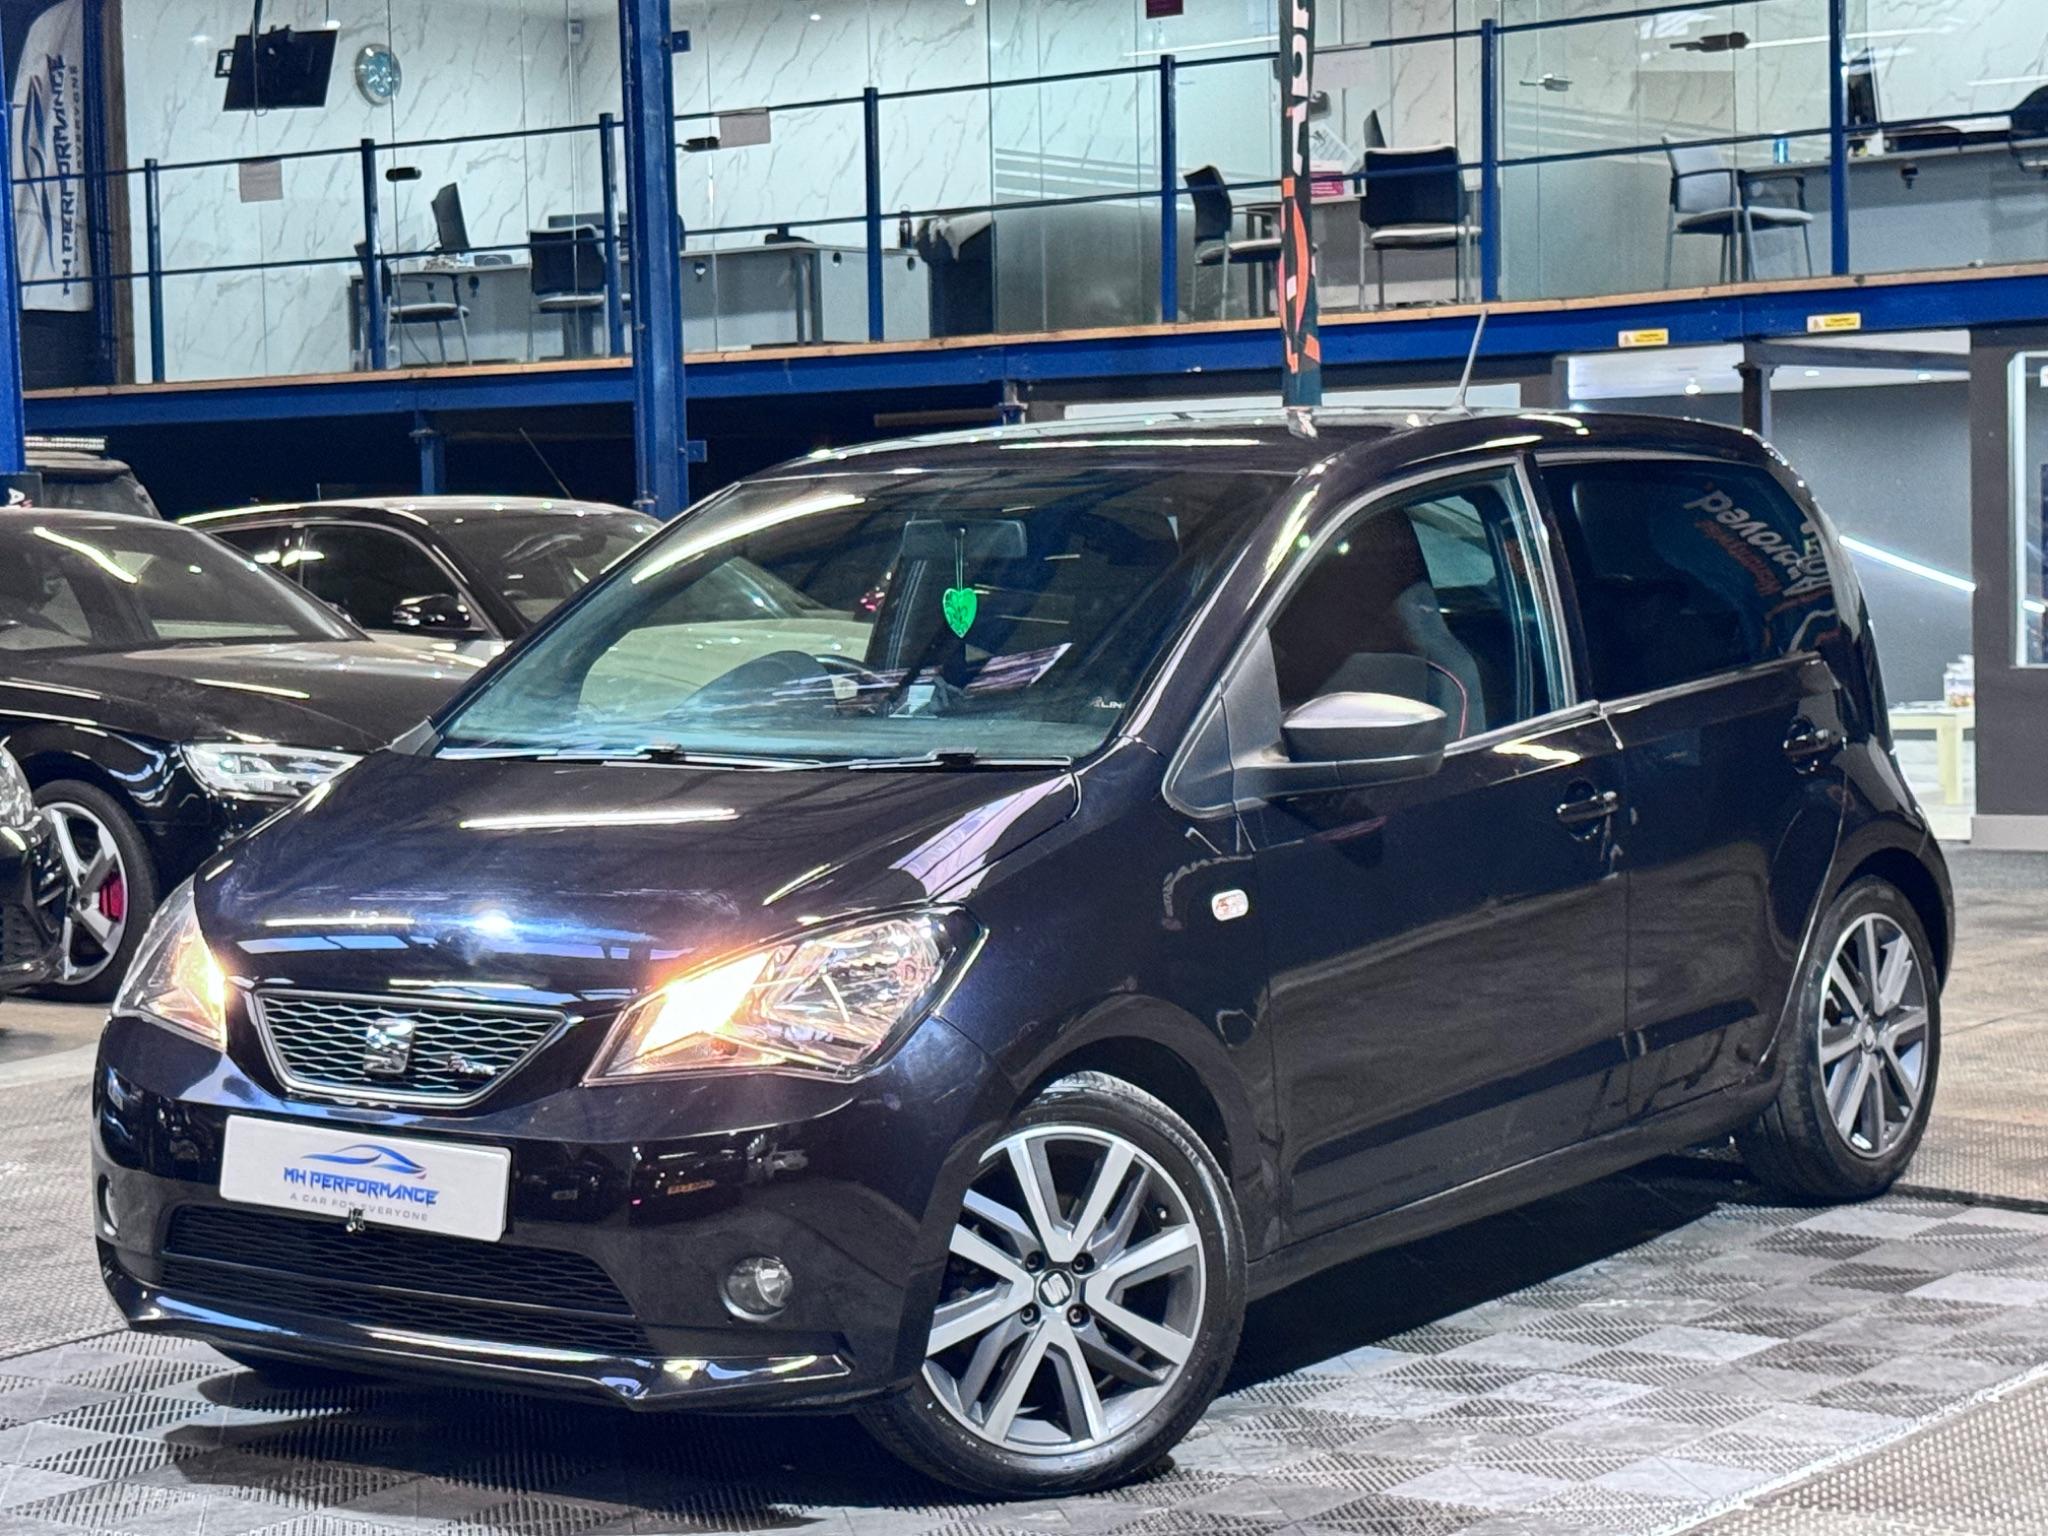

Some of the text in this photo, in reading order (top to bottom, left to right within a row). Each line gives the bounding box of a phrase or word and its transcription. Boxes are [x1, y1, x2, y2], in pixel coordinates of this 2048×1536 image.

[45, 53, 75, 254] PERFORMANCE
[283, 1167, 440, 1208] MH PERFORMANCE
[290, 1192, 297, 1201] A
[302, 1194, 327, 1205] CAR
